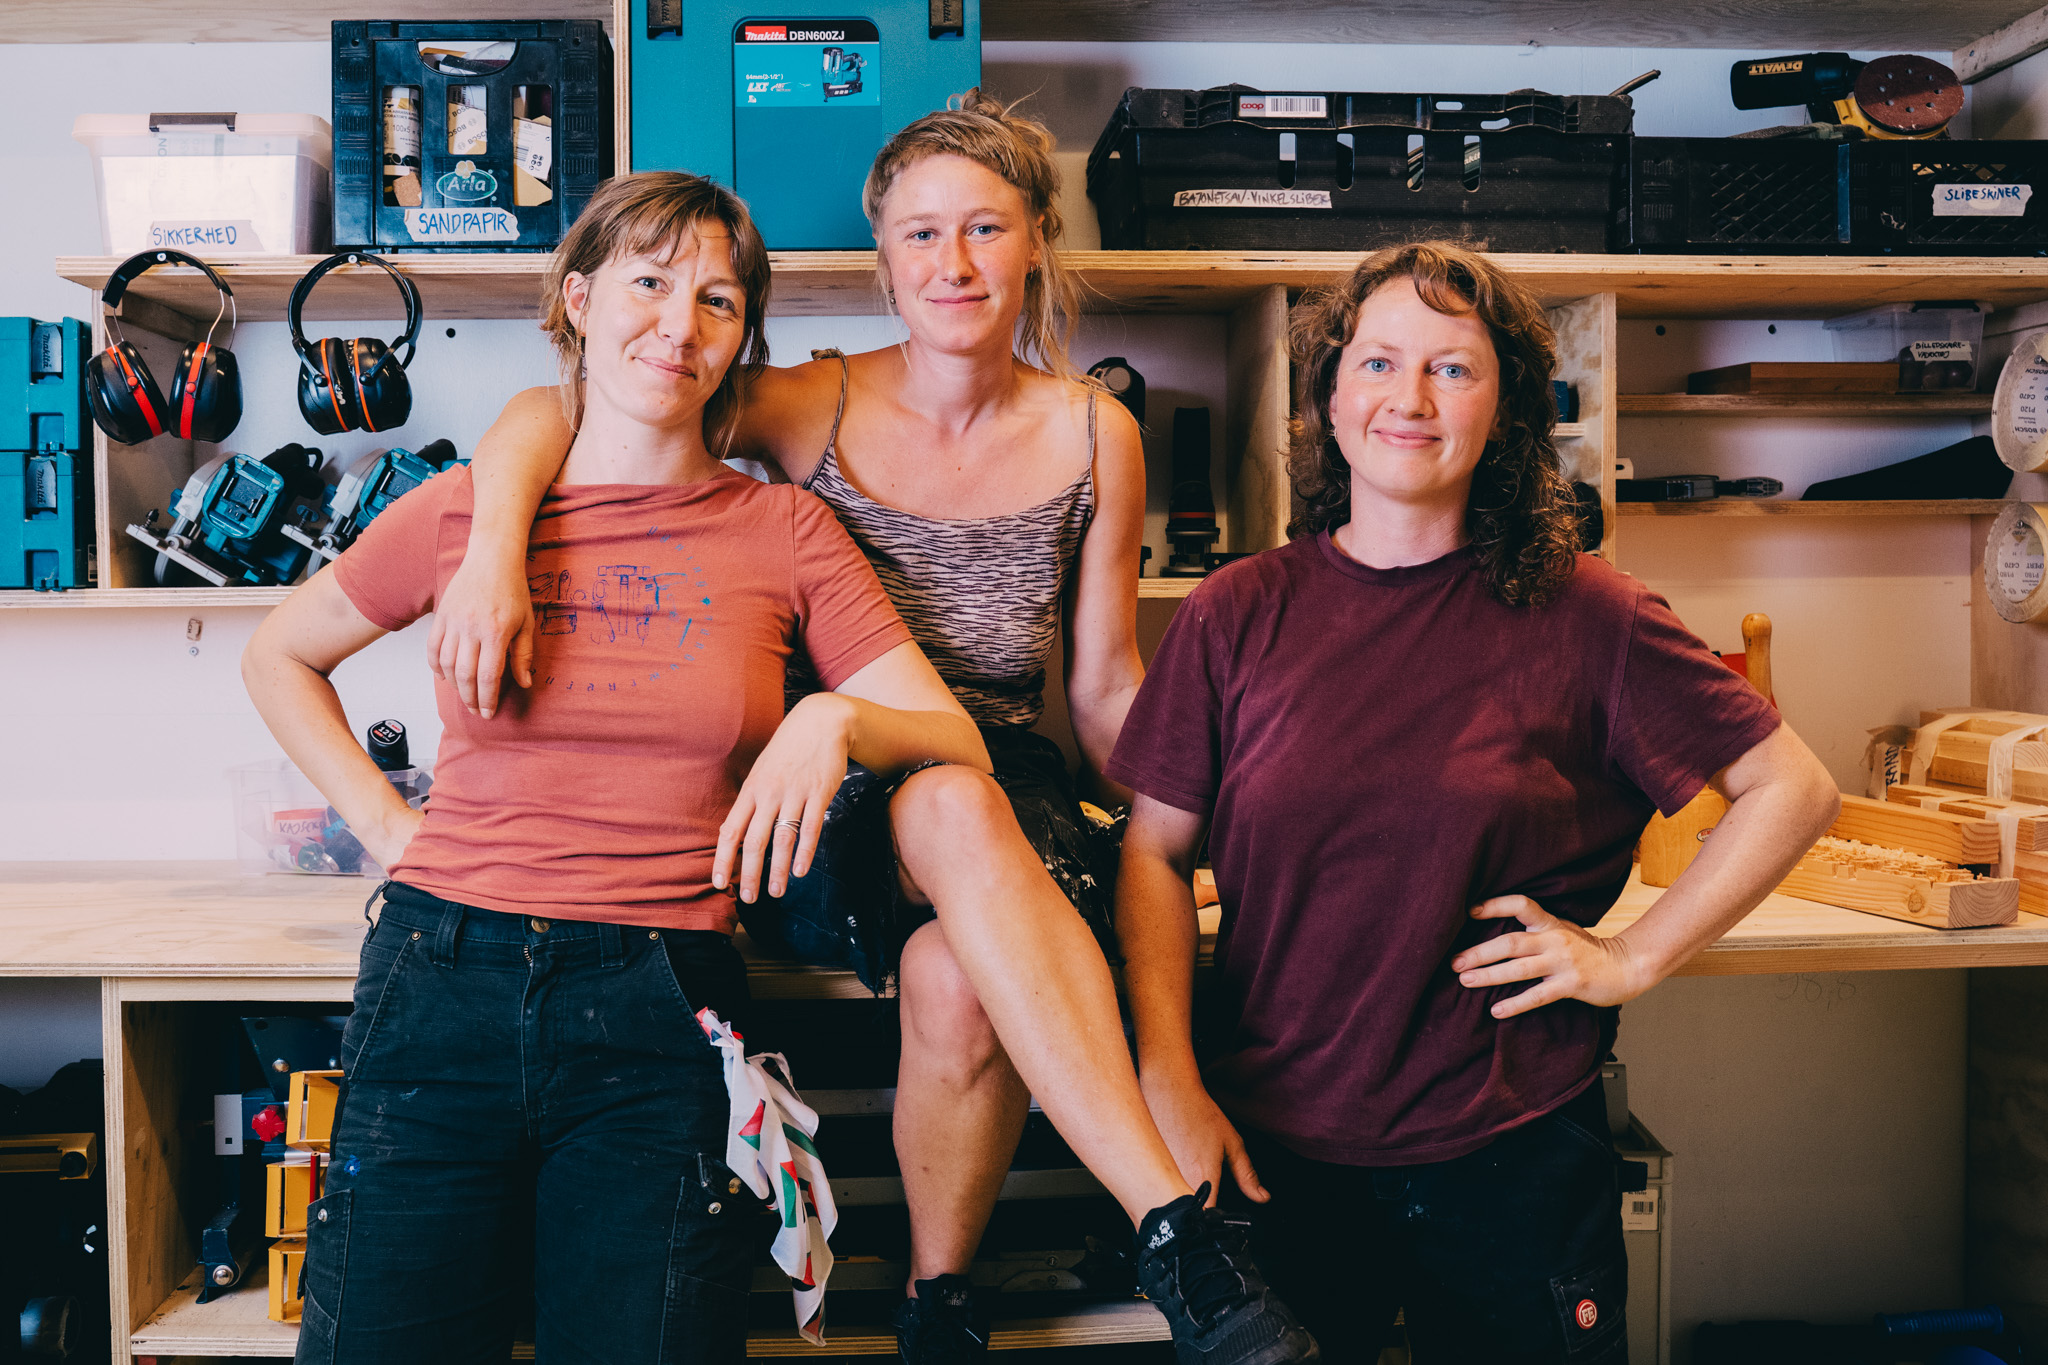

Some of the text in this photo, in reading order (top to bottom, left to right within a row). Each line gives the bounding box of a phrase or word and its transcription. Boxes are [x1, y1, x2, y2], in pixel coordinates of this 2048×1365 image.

[789, 30, 845, 41] DBN600ZJ
[747, 82, 770, 92] LXT
[1241, 102, 1265, 111] coop
[447, 175, 486, 192] Arla
[418, 212, 510, 235] SANDPAPIR
[378, 726, 396, 739] 12V
